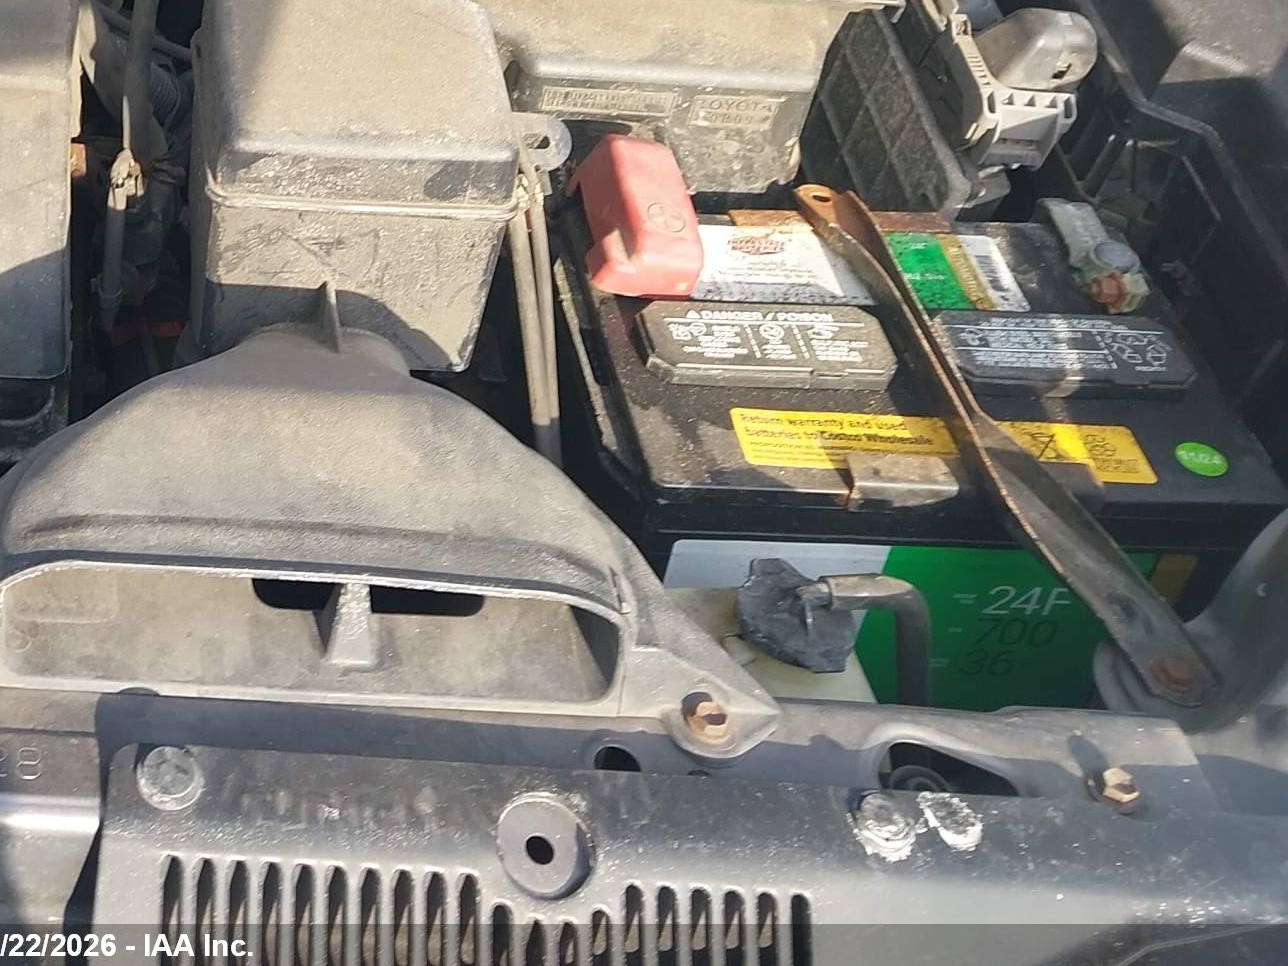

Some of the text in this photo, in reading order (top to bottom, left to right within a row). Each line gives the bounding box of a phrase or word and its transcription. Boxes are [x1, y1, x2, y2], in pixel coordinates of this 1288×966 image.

[695, 97, 773, 113] TOYOTA
[700, 310, 763, 321] DANGER
[775, 312, 835, 323] POISON
[740, 413, 905, 430] Return warranty and used
[743, 426, 934, 446] batteries to Costco Wholesale
[982, 585, 1073, 616] 24F
[971, 617, 1058, 647] 700
[959, 649, 1017, 676] 36
